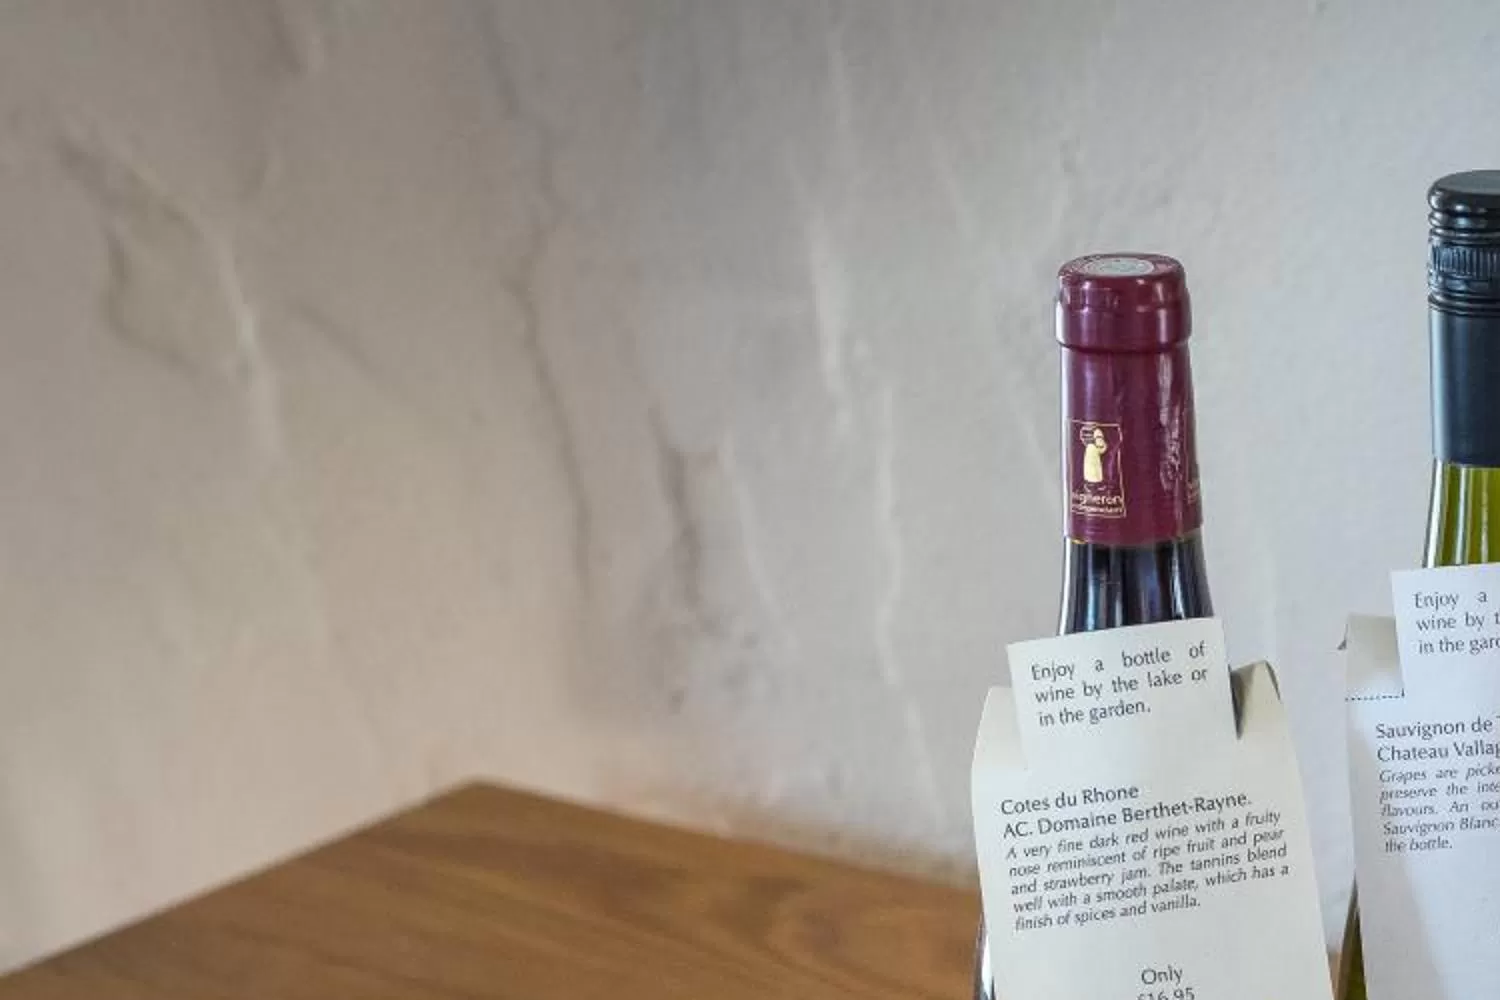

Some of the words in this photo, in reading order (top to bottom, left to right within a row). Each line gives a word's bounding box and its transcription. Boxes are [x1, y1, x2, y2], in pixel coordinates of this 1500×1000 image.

[1413, 591, 1459, 611] Enjoy
[1477, 591, 1487, 603] a
[1416, 615, 1456, 631] wine
[1465, 612, 1485, 629] by
[1418, 639, 1434, 654] in
[1439, 636, 1465, 653] the
[1031, 663, 1075, 682] Enjoy
[1095, 659, 1104, 672] a
[1122, 647, 1171, 668] bottle
[1189, 640, 1205, 659] of
[1035, 684, 1075, 703] wine
[1083, 680, 1103, 697] by
[1112, 676, 1139, 693] the
[1148, 671, 1182, 689] lake
[1191, 667, 1208, 681] or
[1039, 711, 1054, 727] in
[1059, 707, 1084, 725] the
[1089, 699, 1151, 724] garden.
[1375, 720, 1465, 741] Sauvignon
[1471, 716, 1493, 733] de
[1377, 742, 1449, 763] Chateau
[1379, 767, 1427, 784] Grapes
[1435, 767, 1457, 780] are
[1001, 796, 1050, 816] Cotes
[1055, 791, 1077, 810] du
[1083, 785, 1139, 805] Rhone
[1380, 785, 1437, 804] preserve
[1446, 781, 1467, 796] the
[1003, 819, 1033, 839] AC.
[1038, 811, 1117, 835] Domaine
[1123, 790, 1252, 823] Berthet-Rayne.
[1381, 802, 1438, 818] flavours.
[1450, 800, 1470, 813] An
[1006, 847, 1017, 860] A
[1023, 843, 1054, 859] very
[1057, 838, 1083, 854] fine
[1089, 834, 1119, 849] dark
[1125, 829, 1149, 845] red
[1155, 824, 1189, 840] wine
[1195, 819, 1225, 836] with
[1231, 817, 1240, 830] a
[1245, 810, 1281, 829] fruity
[1383, 820, 1455, 837] Sauvignon
[1009, 863, 1041, 877] nose
[1046, 851, 1126, 873] reminiscent
[1132, 847, 1148, 862] of
[1152, 844, 1181, 863] ripe
[1186, 837, 1215, 853] fruit
[1221, 832, 1248, 849] and
[1252, 829, 1284, 847] pear
[1385, 838, 1405, 853] the
[1409, 836, 1453, 852] bottle.
[1011, 880, 1037, 896] and
[1043, 867, 1115, 892] strawberry
[1120, 866, 1151, 886] jam.
[1158, 860, 1183, 875] The
[1190, 852, 1241, 871] tannins
[1247, 843, 1288, 862] blend
[1013, 896, 1043, 914] well
[1047, 891, 1077, 909] with
[1083, 890, 1091, 905] a
[1096, 883, 1148, 903] smooth
[1205, 869, 1247, 888] which
[1251, 864, 1276, 882] has
[1280, 862, 1290, 876] a
[1015, 914, 1053, 932] finish
[1057, 909, 1073, 927] of
[1074, 905, 1117, 930] spices
[1120, 900, 1146, 917] and
[1150, 894, 1201, 914] vanilla.
[1141, 965, 1183, 985] Only
